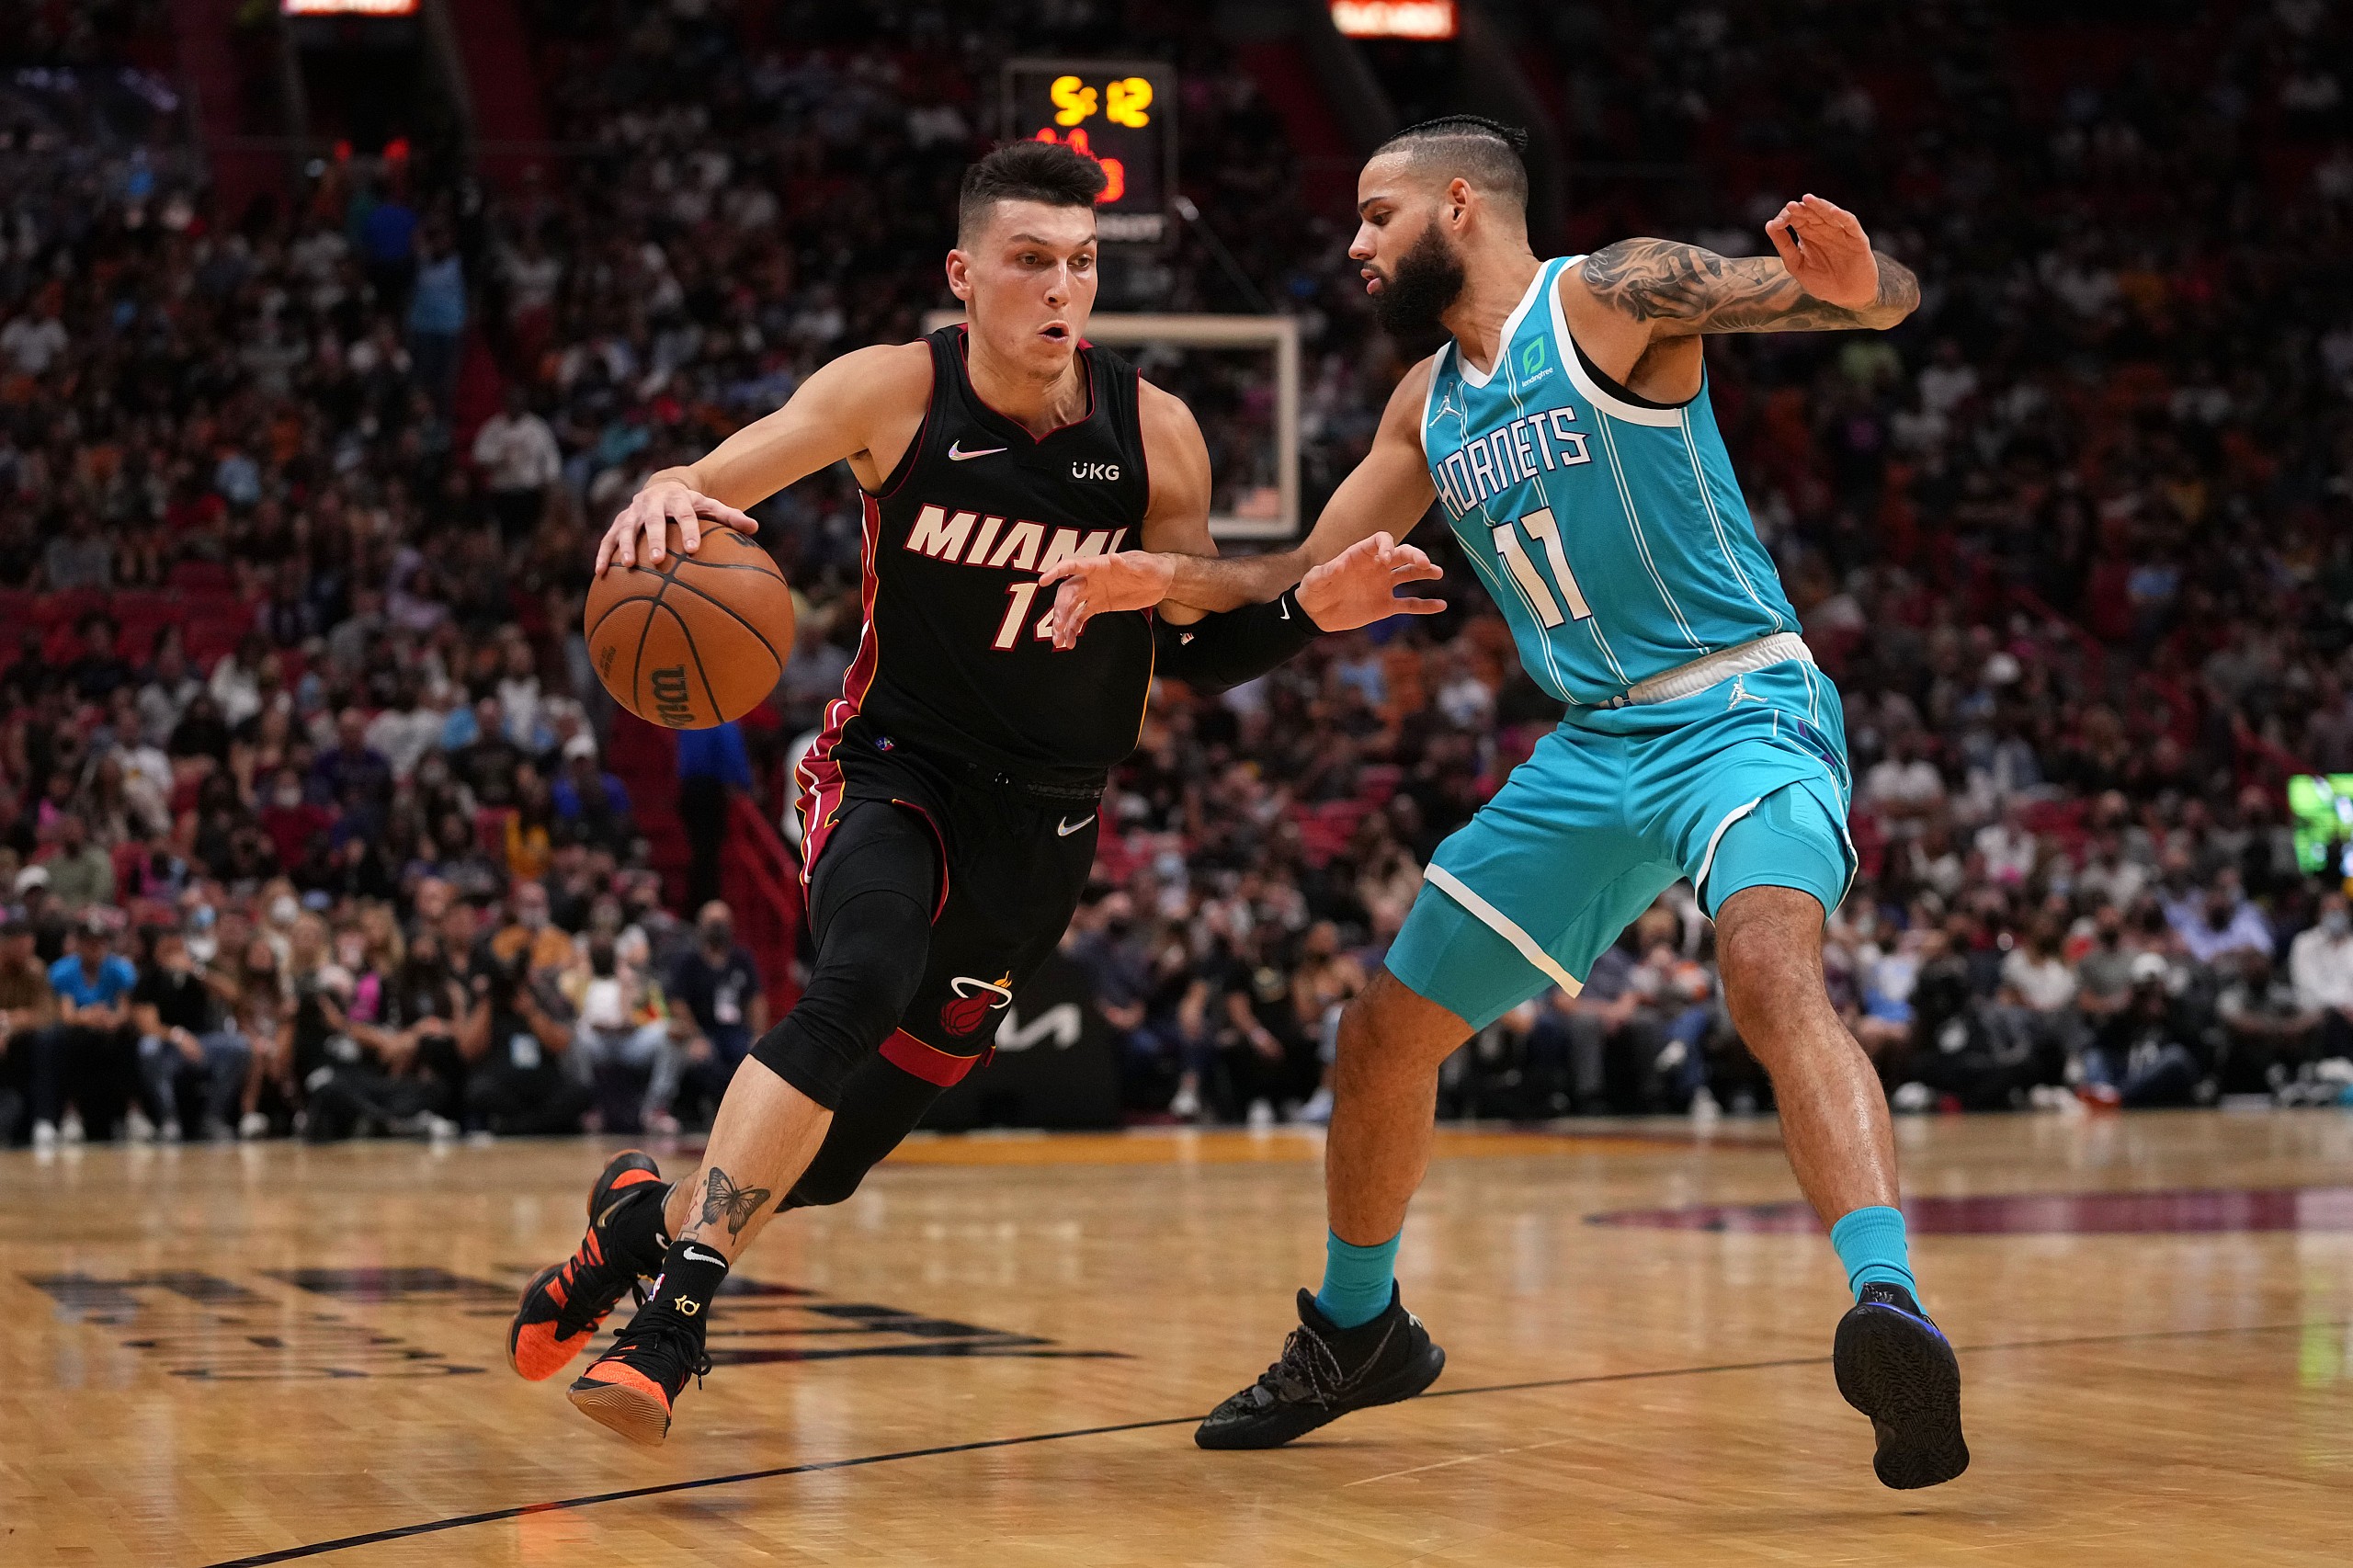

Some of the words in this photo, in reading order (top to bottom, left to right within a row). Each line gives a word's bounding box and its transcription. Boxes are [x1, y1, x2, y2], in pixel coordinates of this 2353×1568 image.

[1051, 75, 1153, 128] 5:12
[1430, 405, 1592, 522] HORNETS
[1492, 506, 1593, 630] 11
